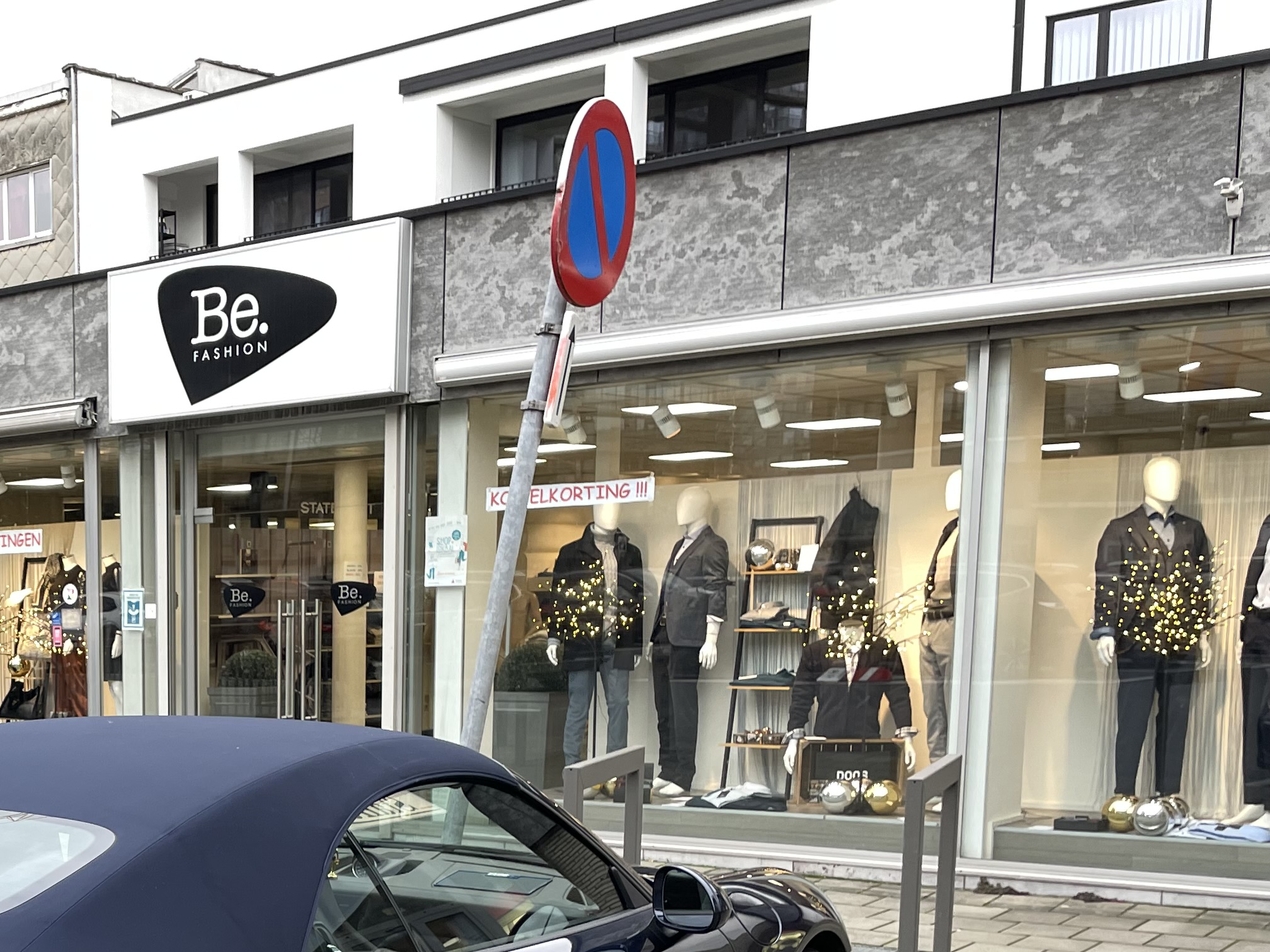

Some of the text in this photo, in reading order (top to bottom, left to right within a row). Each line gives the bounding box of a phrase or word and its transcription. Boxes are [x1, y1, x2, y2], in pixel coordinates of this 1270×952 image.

[191, 286, 268, 345] Be.
[193, 340, 268, 362] FASHION
[490, 481, 648, 507] KOELKORTING !!!
[230, 588, 252, 603] Be.
[338, 584, 362, 599] Be.
